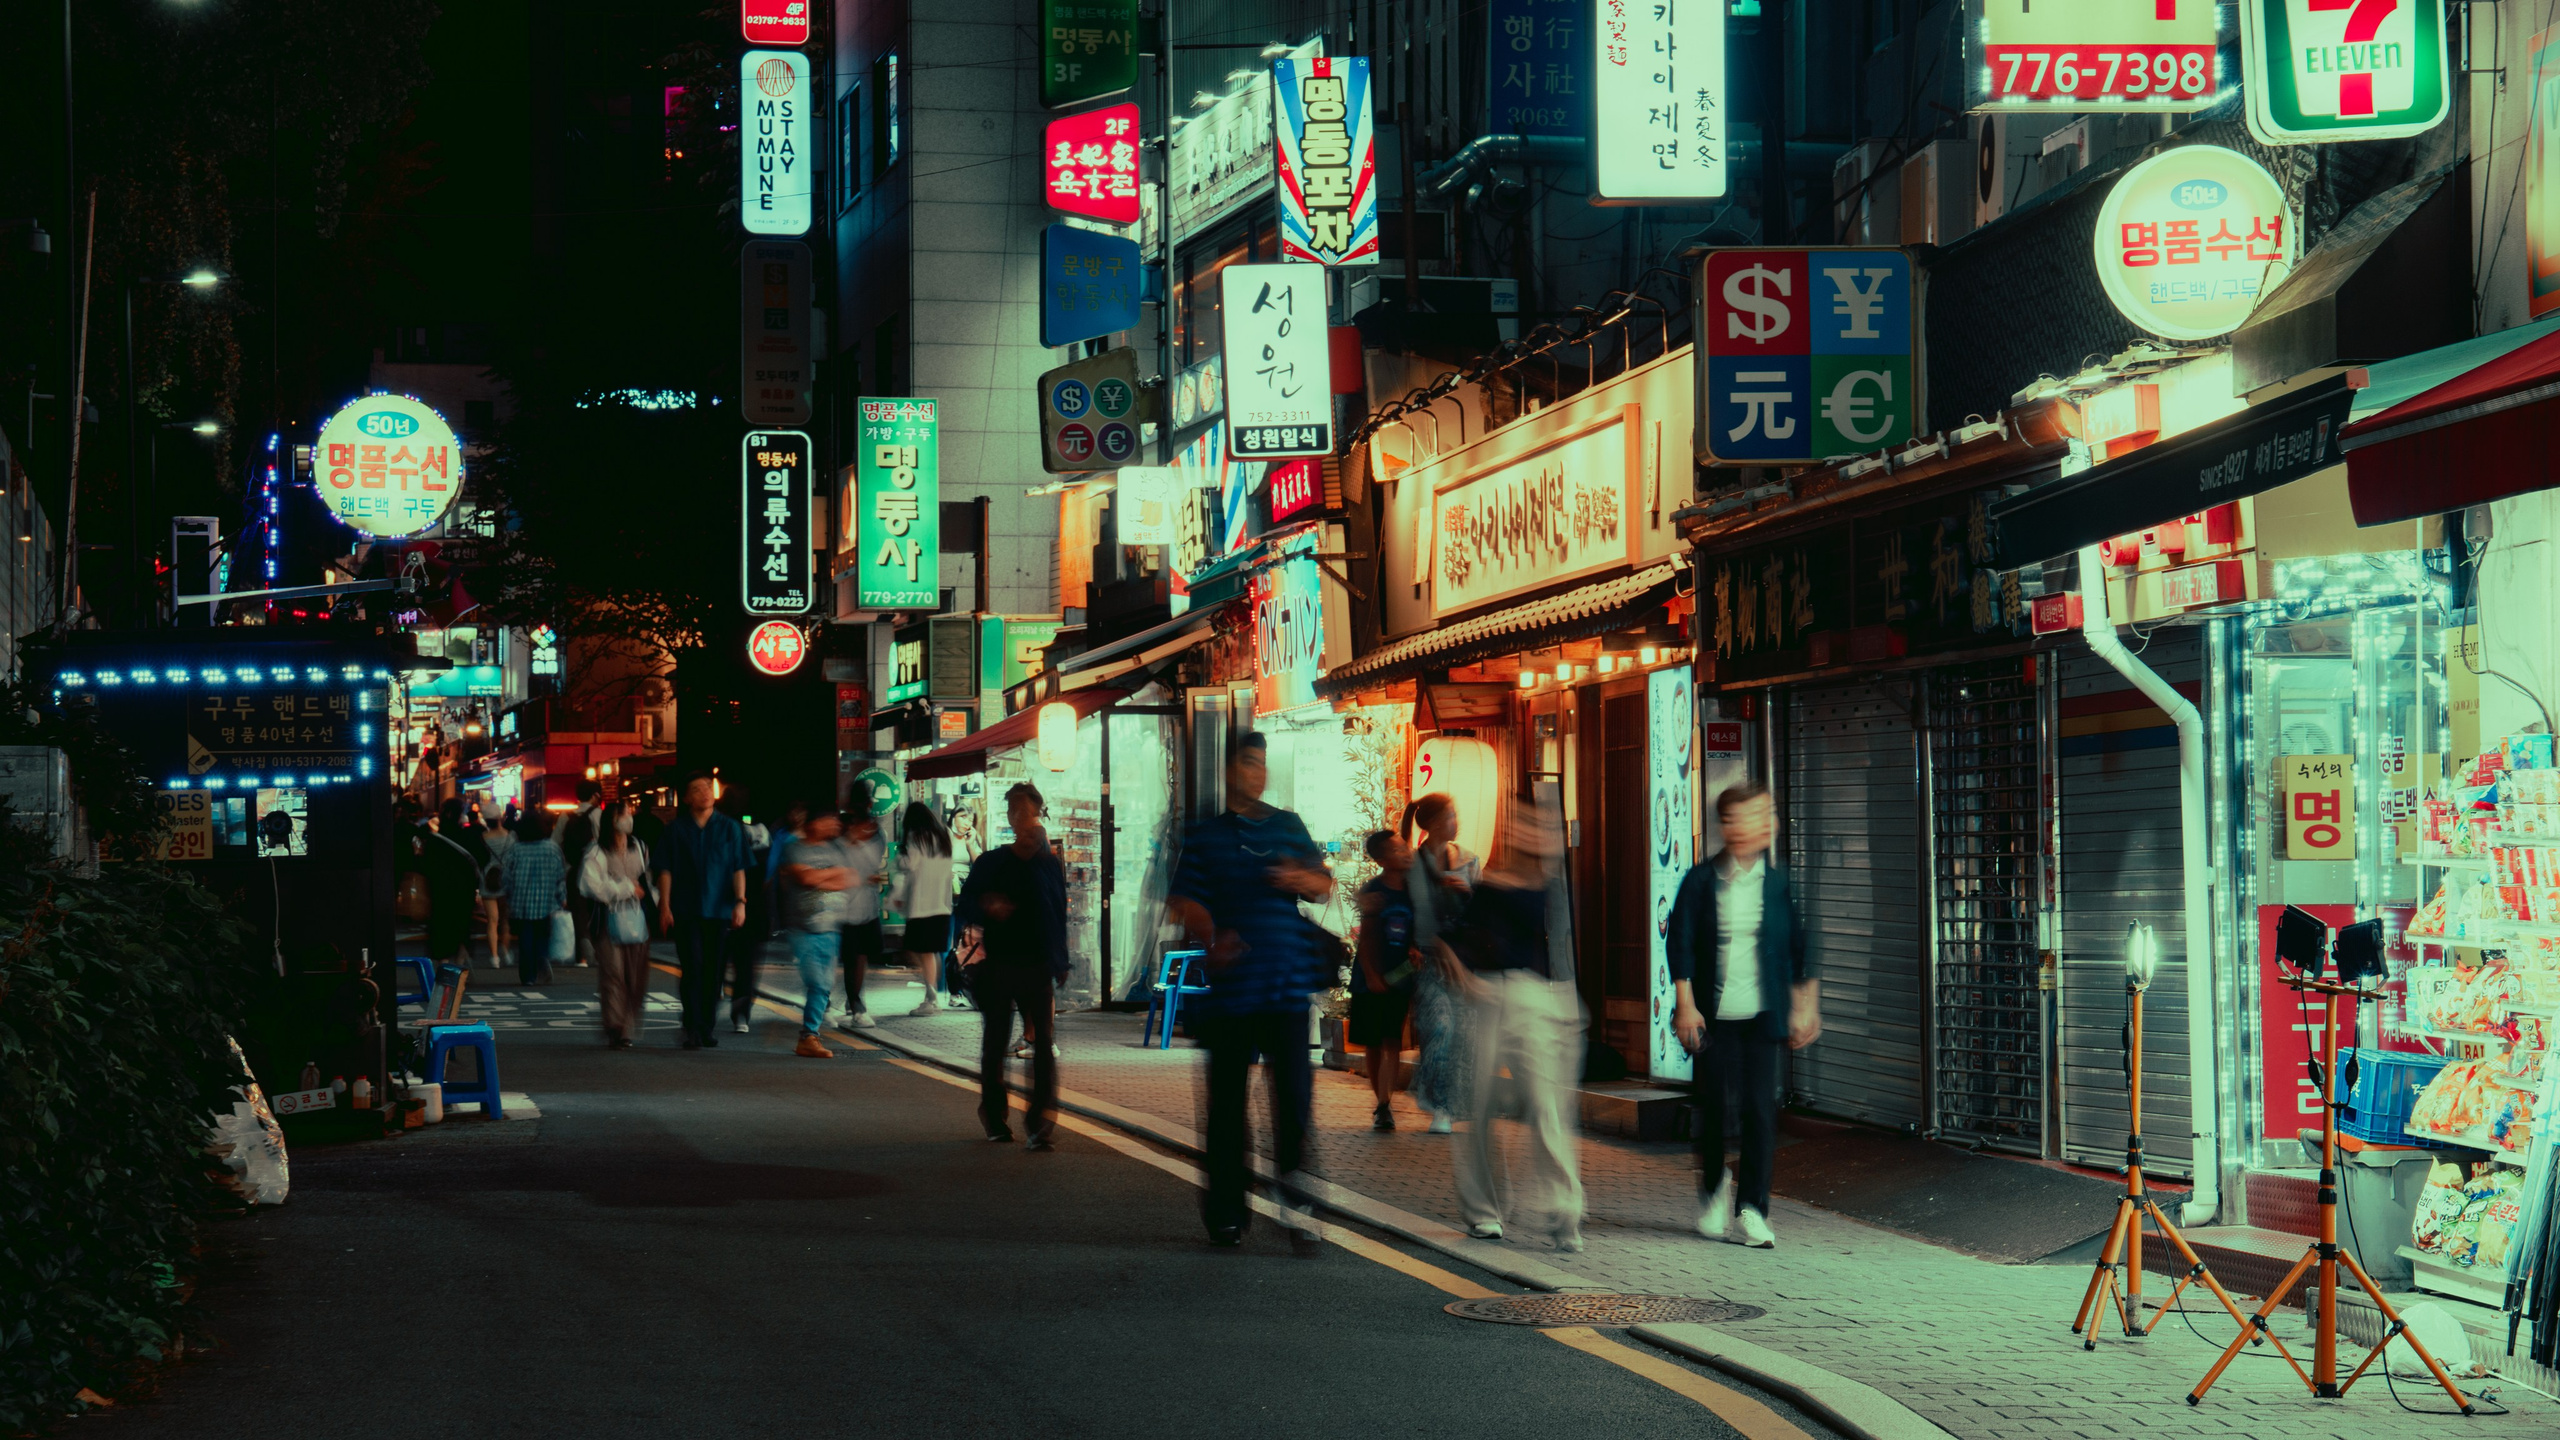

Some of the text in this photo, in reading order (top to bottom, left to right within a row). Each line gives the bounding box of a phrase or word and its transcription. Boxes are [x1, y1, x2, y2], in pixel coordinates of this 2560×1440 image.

[786, 3, 804, 15] 4F
[1055, 6, 1130, 20] 명품 핸드백 수선
[1052, 27, 1132, 56] 명동사
[1054, 63, 1082, 82] 3F
[2000, 53, 2206, 94] 776-7398
[1105, 119, 1130, 135] 2F
[1507, 106, 1569, 127] 306호
[1693, 87, 1718, 168] 春夏冬
[780, 100, 795, 173] STAY
[757, 100, 775, 210] MUMUNE
[1051, 141, 1135, 171] 王妃家
[1301, 76, 1353, 254] 명동포차
[2181, 186, 2219, 204] 50년
[2121, 217, 2283, 267] 명품수선
[1062, 255, 1124, 278] 문방구
[1057, 283, 1129, 312] 합동사
[1722, 263, 1792, 344] $
[1251, 281, 1303, 398] 성원
[1060, 385, 1084, 413] $
[1727, 371, 1796, 443] 元
[863, 402, 935, 422] 명품수선
[1248, 411, 1311, 423] 752-3311
[366, 415, 411, 435] 50년
[750, 436, 767, 447] B1
[1063, 430, 1088, 454] 元
[1243, 427, 1318, 449] 성원일식
[329, 444, 448, 491] 명품수선
[757, 452, 798, 467] 명동사
[2198, 462, 2223, 493] SINCE
[2223, 449, 2248, 486] 1927
[341, 496, 436, 519] 핸드백 구두
[876, 444, 922, 583] 명동사
[762, 468, 791, 581] 의류수선
[751, 597, 805, 607] 779-0222
[787, 589, 804, 597] TEL.
[863, 592, 934, 604] 779-2770
[755, 637, 800, 659] 사주
[203, 694, 350, 721] 구두 핸드백
[1711, 732, 1738, 743] 에스원
[271, 755, 353, 768] 010-5317-2083
[1707, 751, 1731, 760] SECOM
[2298, 762, 2343, 779] 수선의
[2294, 789, 2342, 848] 명
